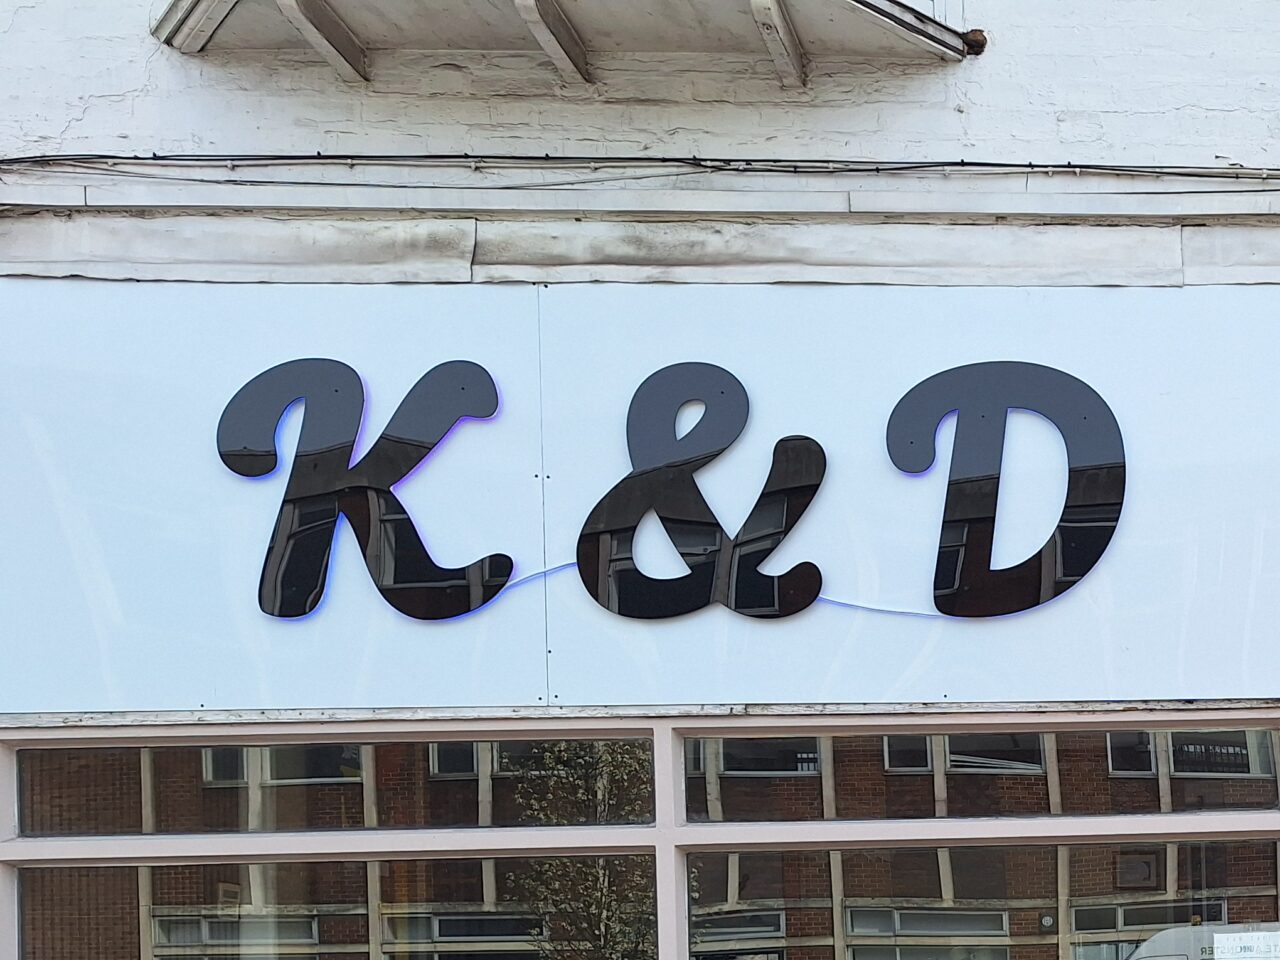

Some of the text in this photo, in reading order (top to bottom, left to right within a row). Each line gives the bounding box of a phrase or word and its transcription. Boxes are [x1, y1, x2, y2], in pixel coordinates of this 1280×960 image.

[216, 357, 1127, 622] K & D
